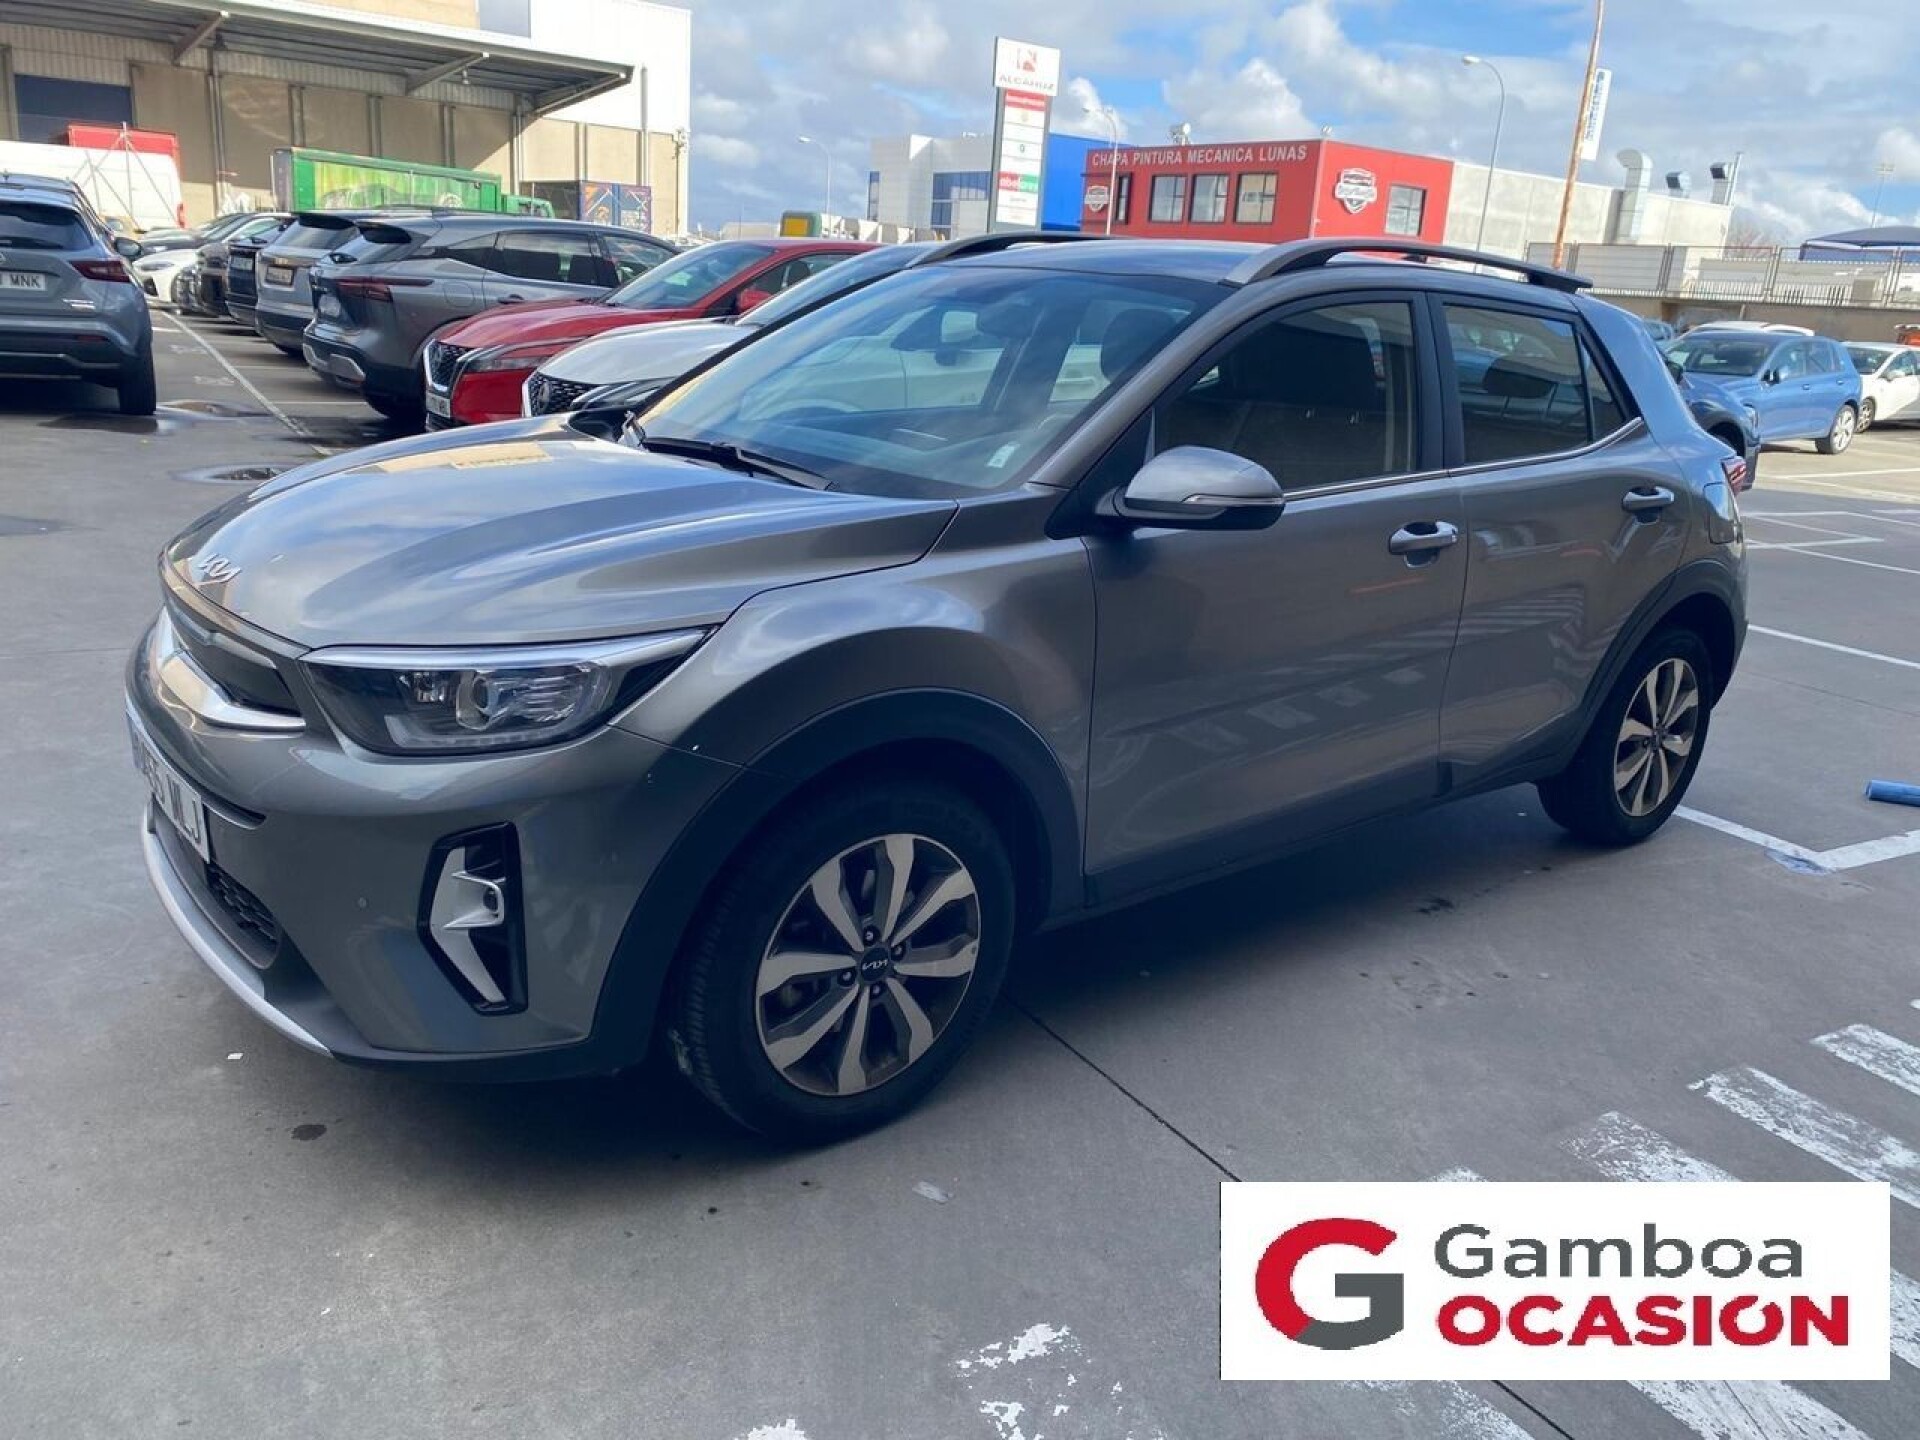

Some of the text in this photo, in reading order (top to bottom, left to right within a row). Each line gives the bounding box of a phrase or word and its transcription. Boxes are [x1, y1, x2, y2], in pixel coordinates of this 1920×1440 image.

[1091, 144, 1308, 166] CHAPA PINTURA MECANICA LUNAS
